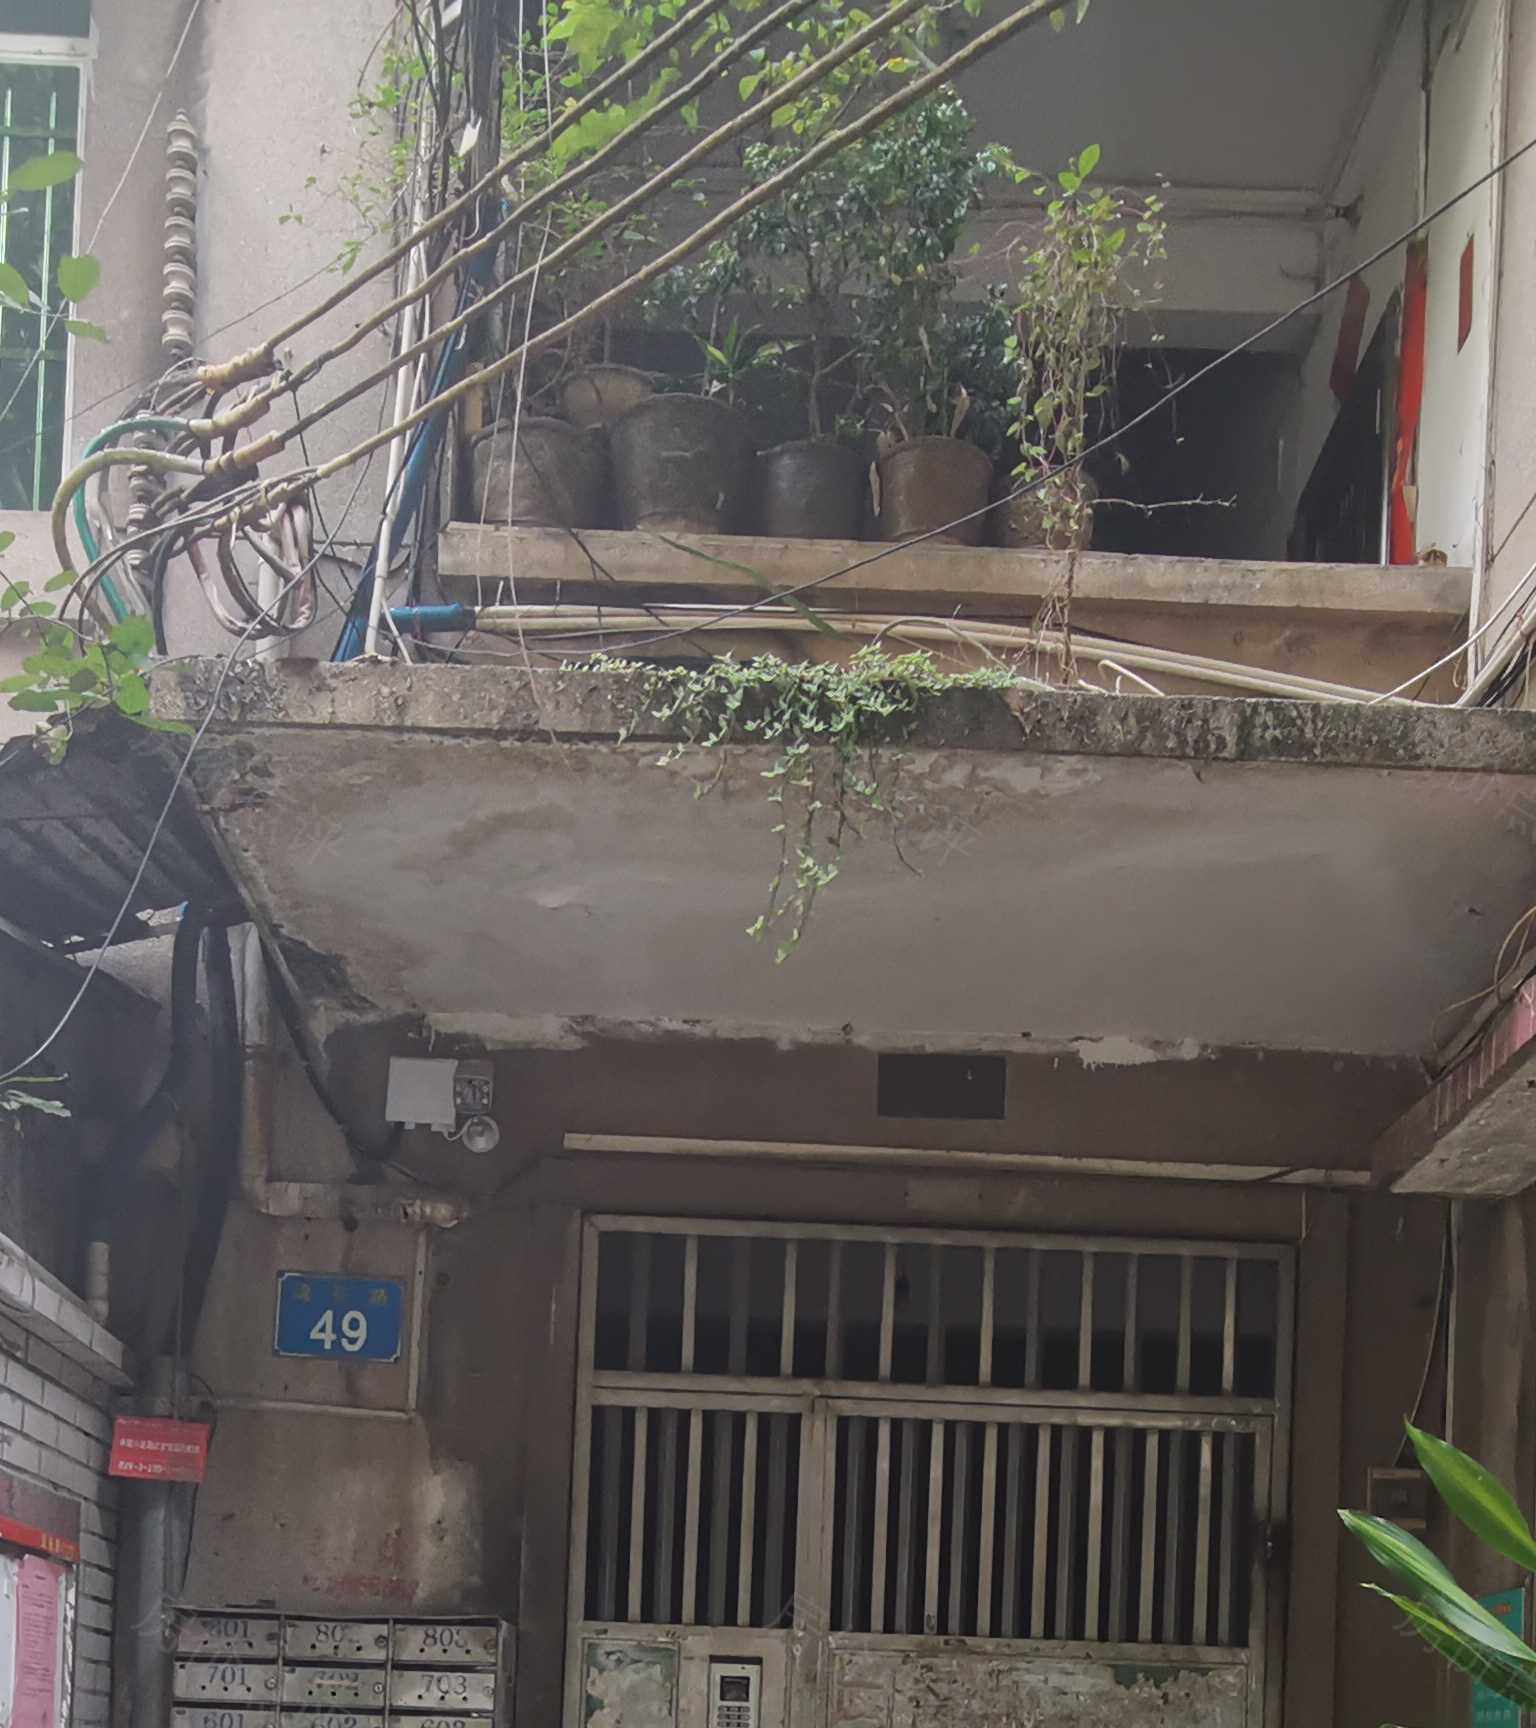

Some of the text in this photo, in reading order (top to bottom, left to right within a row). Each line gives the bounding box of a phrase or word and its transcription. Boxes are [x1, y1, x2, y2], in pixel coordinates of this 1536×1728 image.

[309, 1309, 368, 1352] 49
[208, 1666, 248, 1685] 701
[423, 1675, 467, 1694] 703
